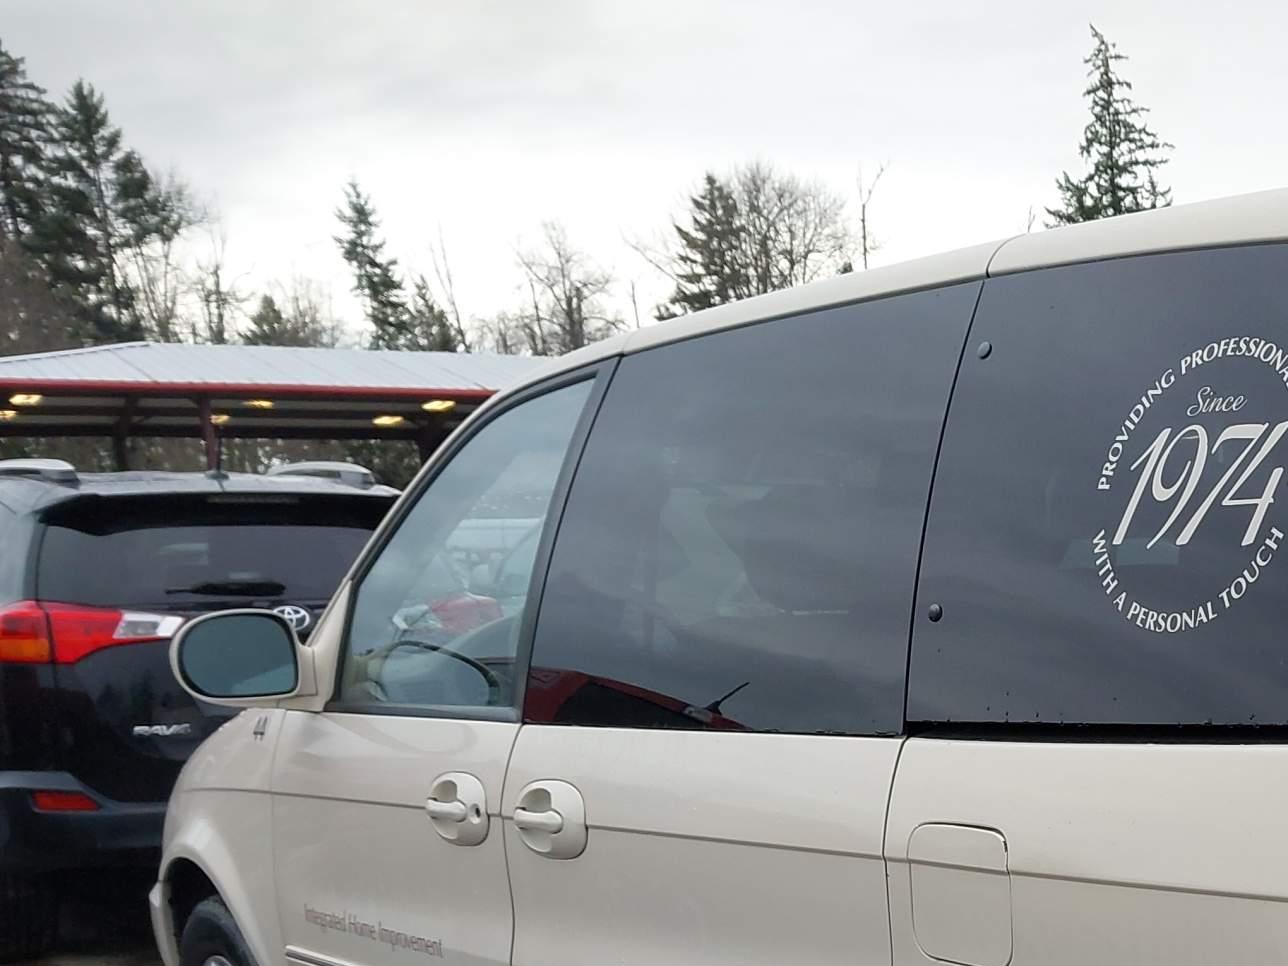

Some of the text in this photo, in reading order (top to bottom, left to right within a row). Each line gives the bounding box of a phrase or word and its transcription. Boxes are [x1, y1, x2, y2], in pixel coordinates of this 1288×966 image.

[1098, 369, 1175, 490] PROVIDING
[1187, 386, 1247, 416] Since
[1093, 527, 1284, 632] WITH A PERSONAL TOUCH
[348, 913, 376, 940] Home
[378, 921, 443, 957] Improvement
